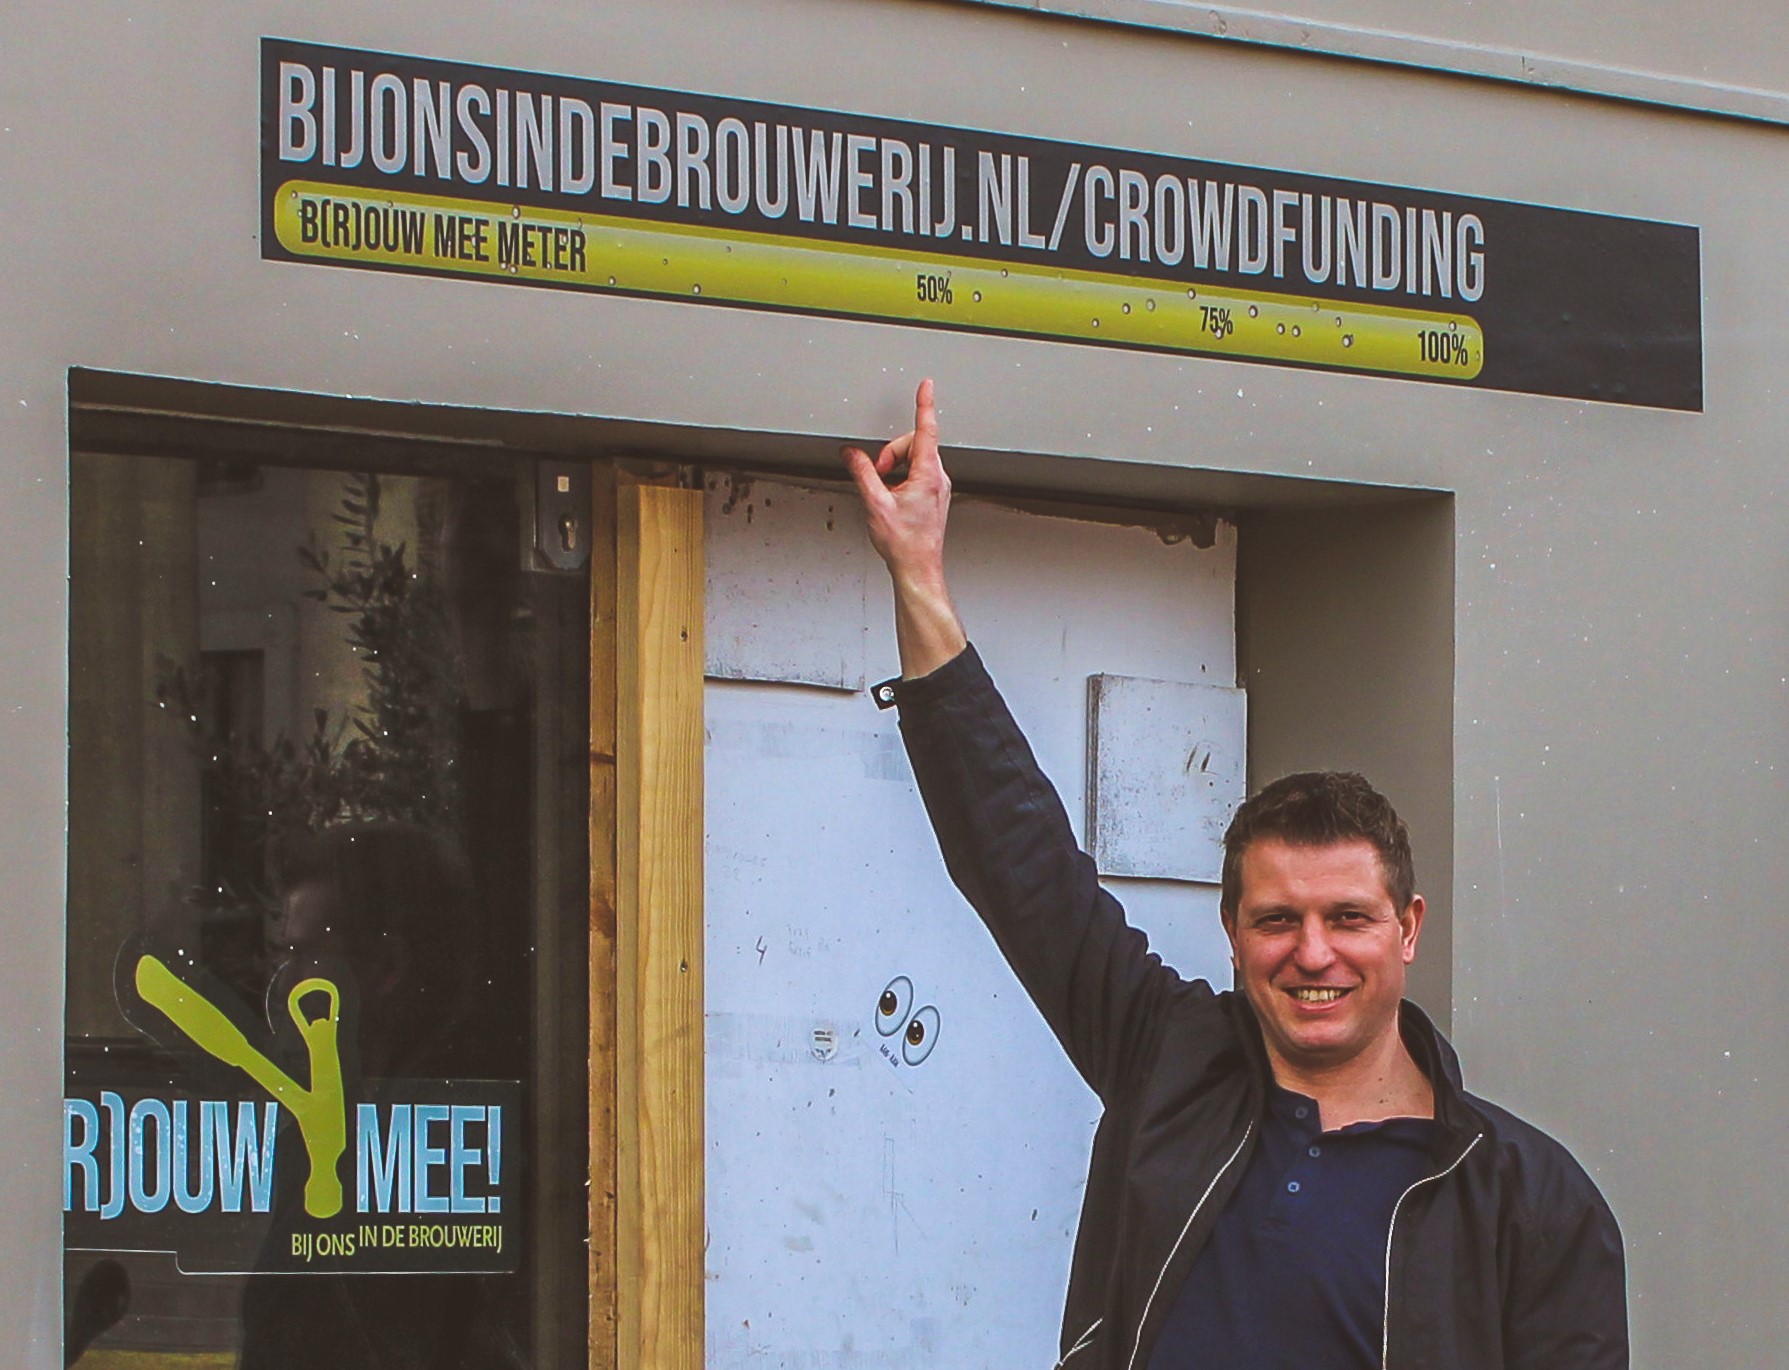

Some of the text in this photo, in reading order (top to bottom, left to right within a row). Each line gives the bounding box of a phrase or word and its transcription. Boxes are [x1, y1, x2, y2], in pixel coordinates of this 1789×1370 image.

[279, 61, 1485, 303] BIJONSINDEBROUWERIJ.NL/CROWDFUNDING
[301, 198, 586, 272] B(R)OUW MEE METER
[916, 273, 953, 305] 50%
[1199, 305, 1233, 335] 75%
[1417, 329, 1469, 366] 100%
[356, 1103, 501, 1213] MEE!
[291, 1225, 502, 1263] BIJ ONS IN DE BROUWERIJ
